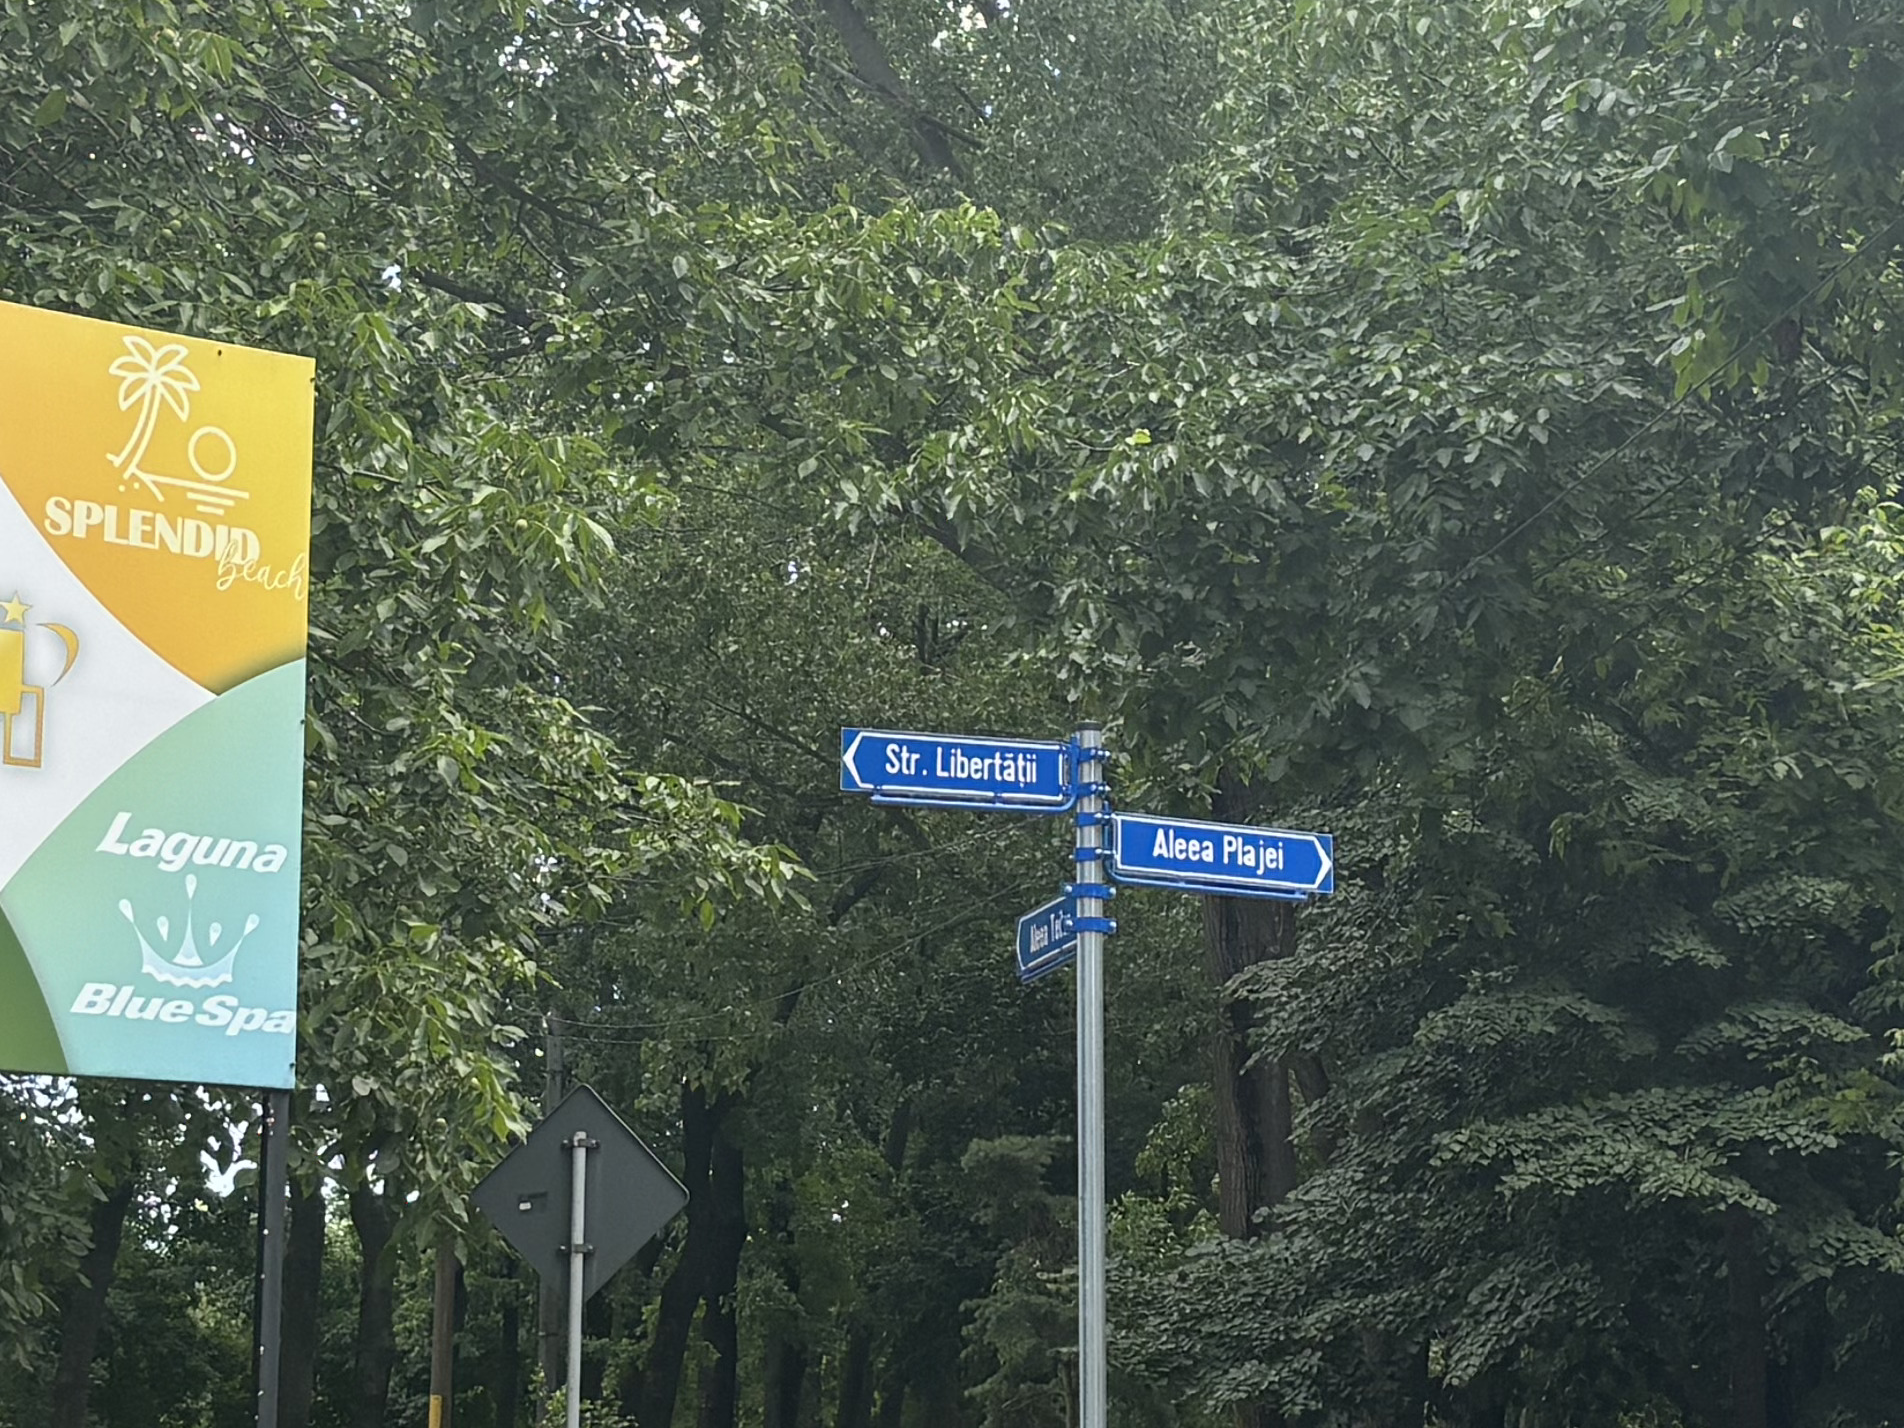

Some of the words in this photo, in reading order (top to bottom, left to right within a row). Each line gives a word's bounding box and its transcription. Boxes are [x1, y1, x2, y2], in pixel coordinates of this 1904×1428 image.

[44, 496, 261, 565] SPLENDID
[216, 539, 307, 601] beach
[885, 743, 928, 776] Str.
[94, 811, 288, 873] Laguna
[1152, 828, 1214, 863] Aleea
[1223, 834, 1284, 875] Plajei
